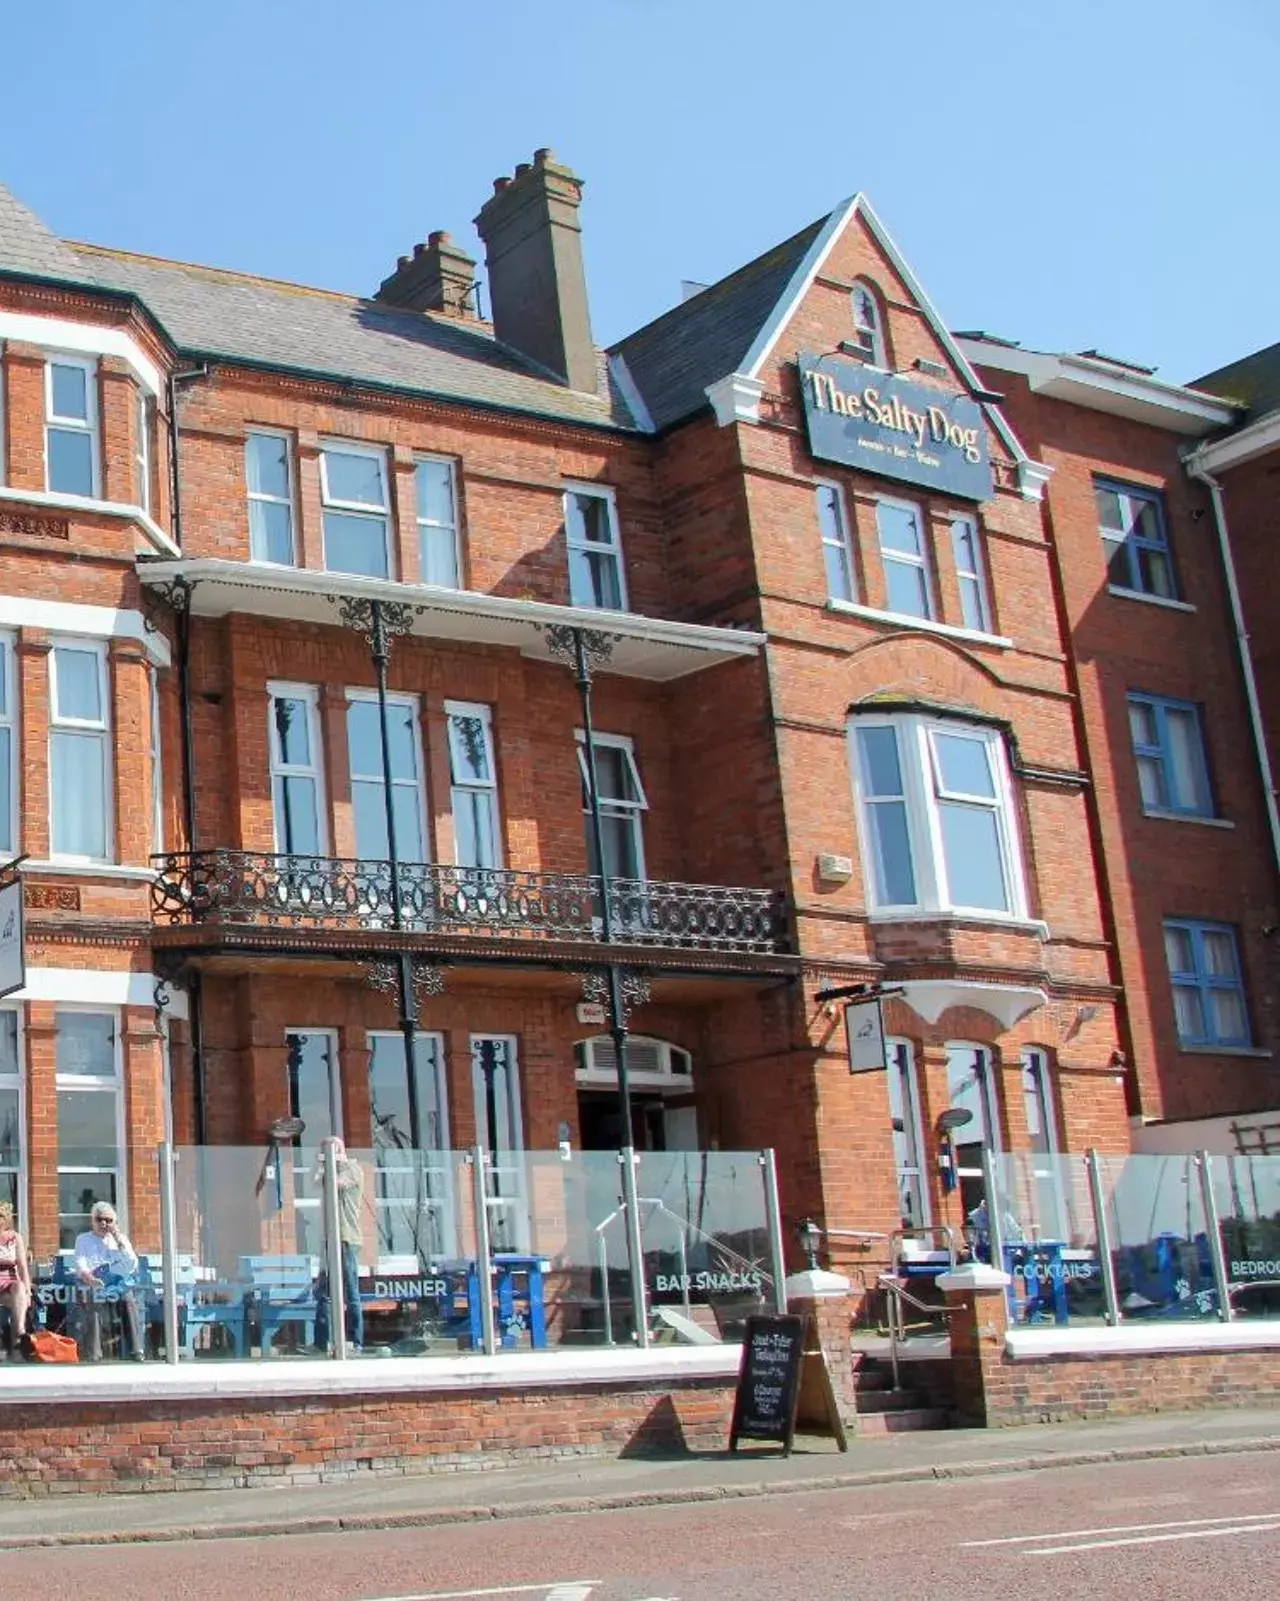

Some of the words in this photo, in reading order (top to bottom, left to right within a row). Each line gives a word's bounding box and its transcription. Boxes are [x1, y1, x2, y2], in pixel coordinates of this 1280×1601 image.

[805, 370, 862, 417] The
[864, 388, 927, 448] Salty
[926, 406, 980, 464] Dog
[1014, 1262, 1091, 1278] COCKTAILS
[374, 1280, 447, 1298] DINNER
[656, 1274, 691, 1291] BAR
[696, 1271, 761, 1290] SNACKS
